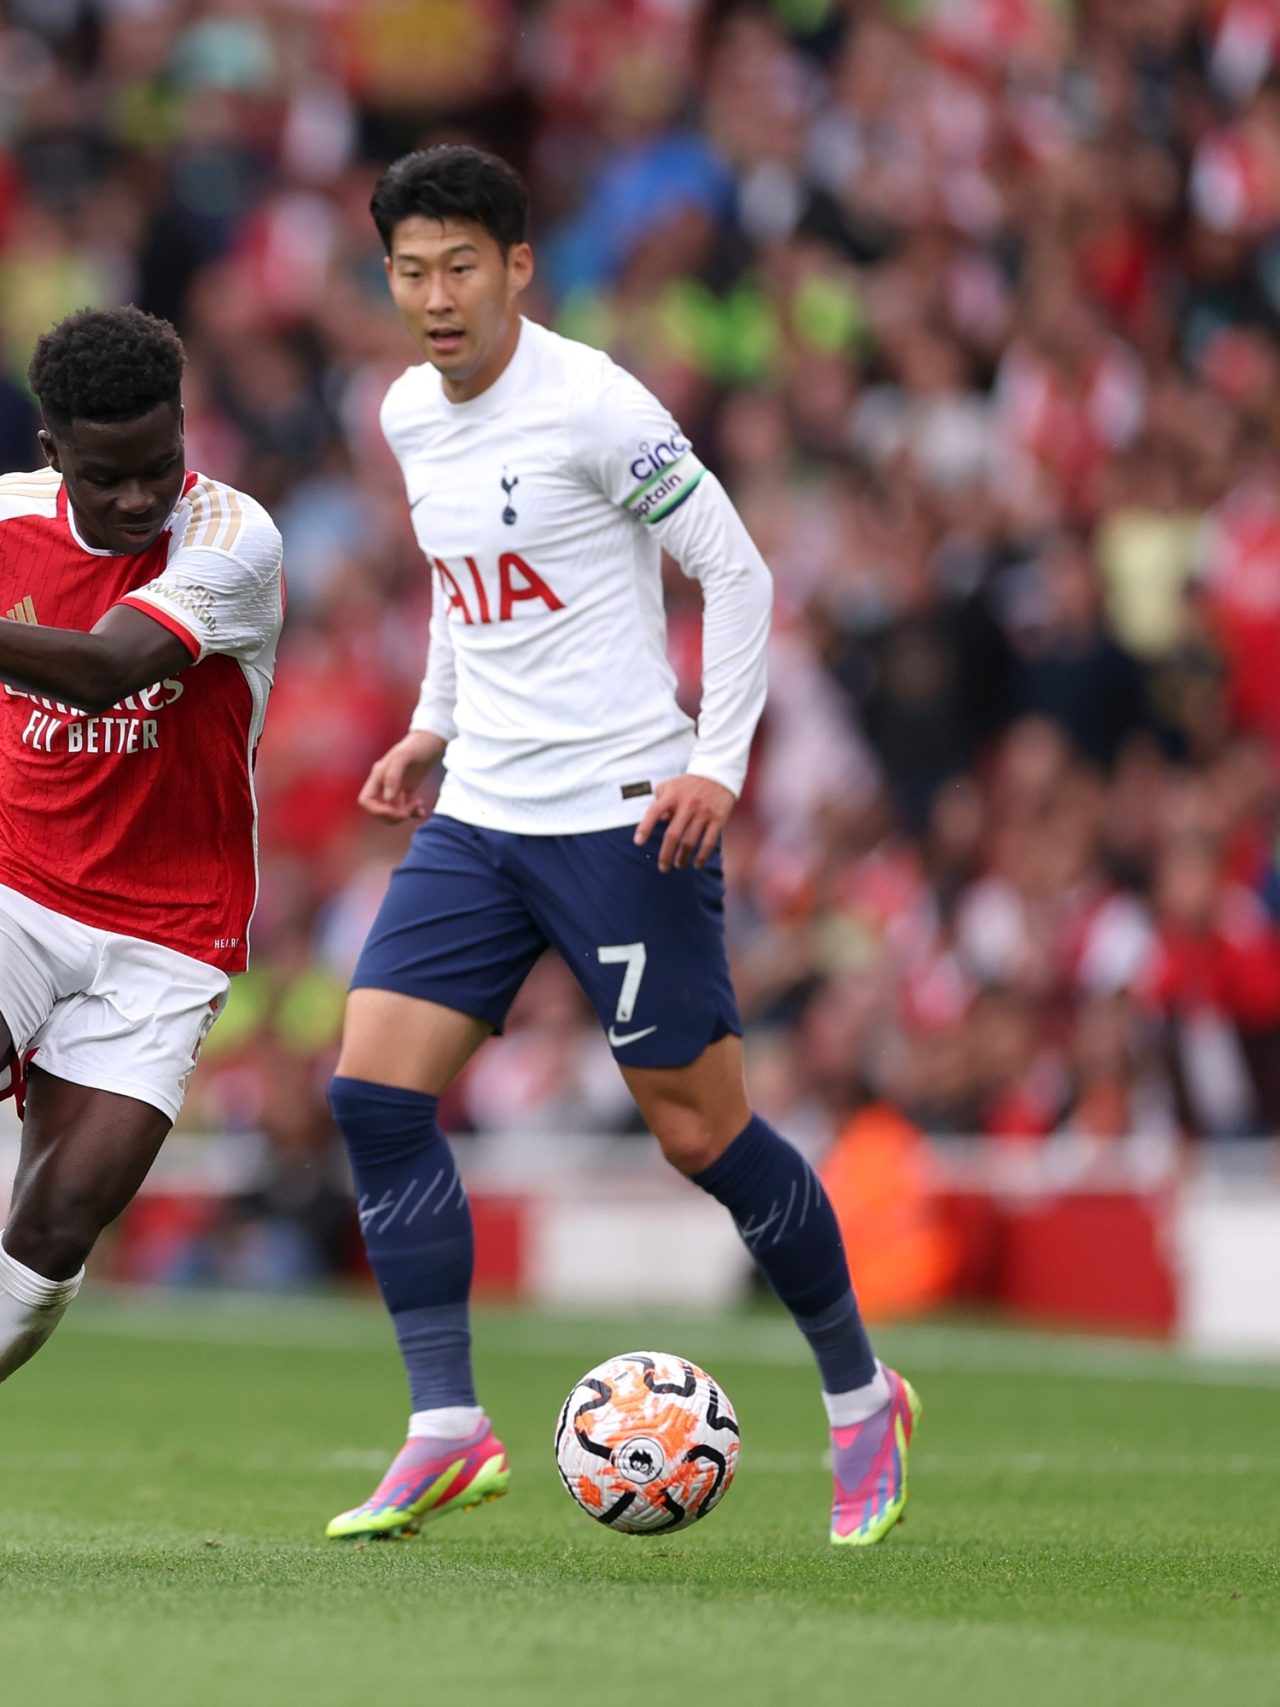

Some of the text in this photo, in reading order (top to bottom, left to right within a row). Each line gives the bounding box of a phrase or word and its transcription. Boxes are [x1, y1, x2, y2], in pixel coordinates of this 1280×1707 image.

[433, 551, 566, 625] AIA
[22, 710, 159, 753] FLY BETTER
[597, 942, 647, 1022] 7
